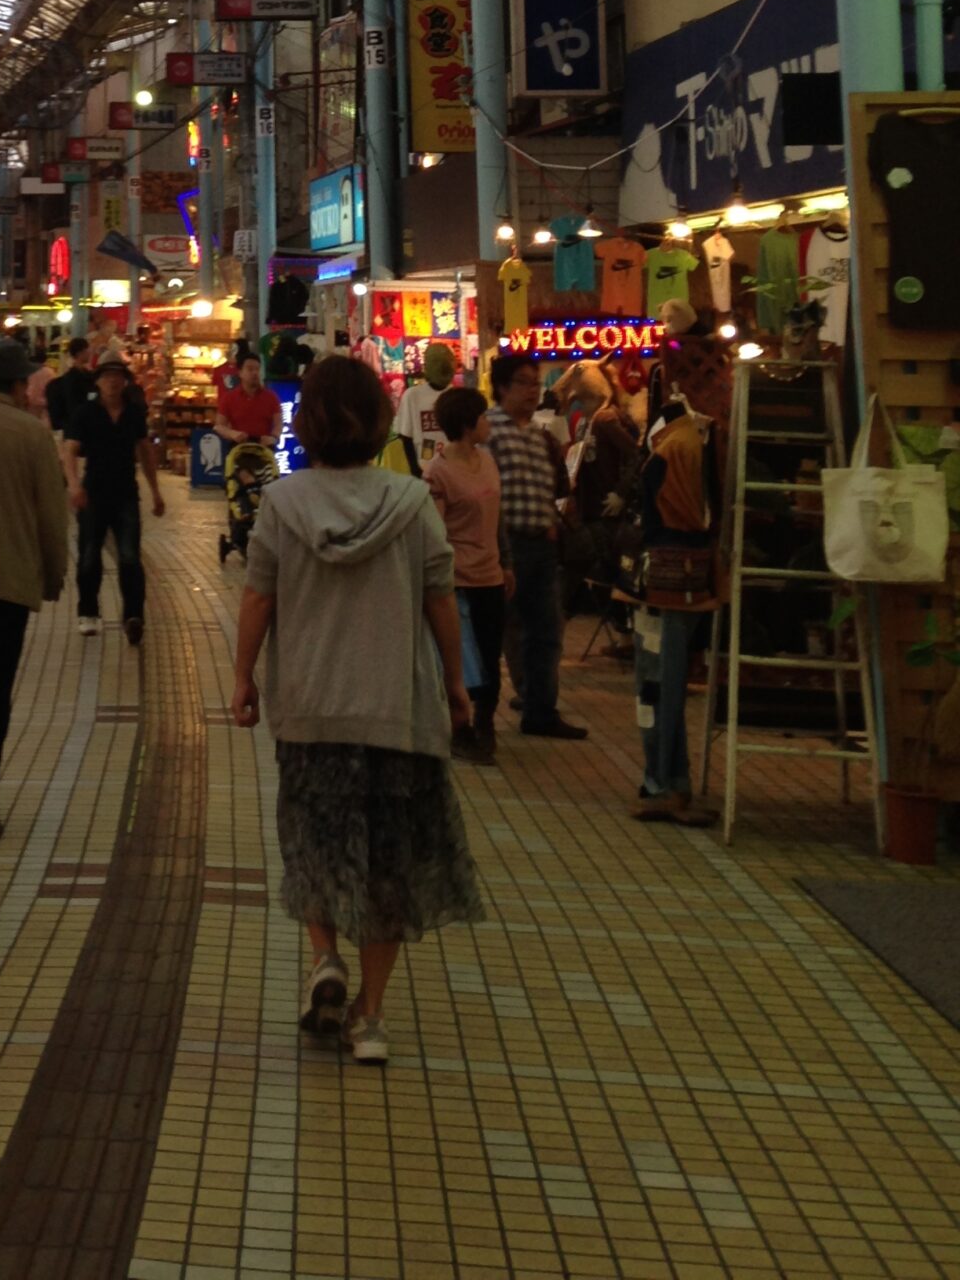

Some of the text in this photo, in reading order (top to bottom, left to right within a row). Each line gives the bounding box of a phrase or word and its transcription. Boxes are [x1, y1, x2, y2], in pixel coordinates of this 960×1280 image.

[367, 30, 383, 45] B
[366, 49, 385, 65] 15
[259, 107, 272, 121] B
